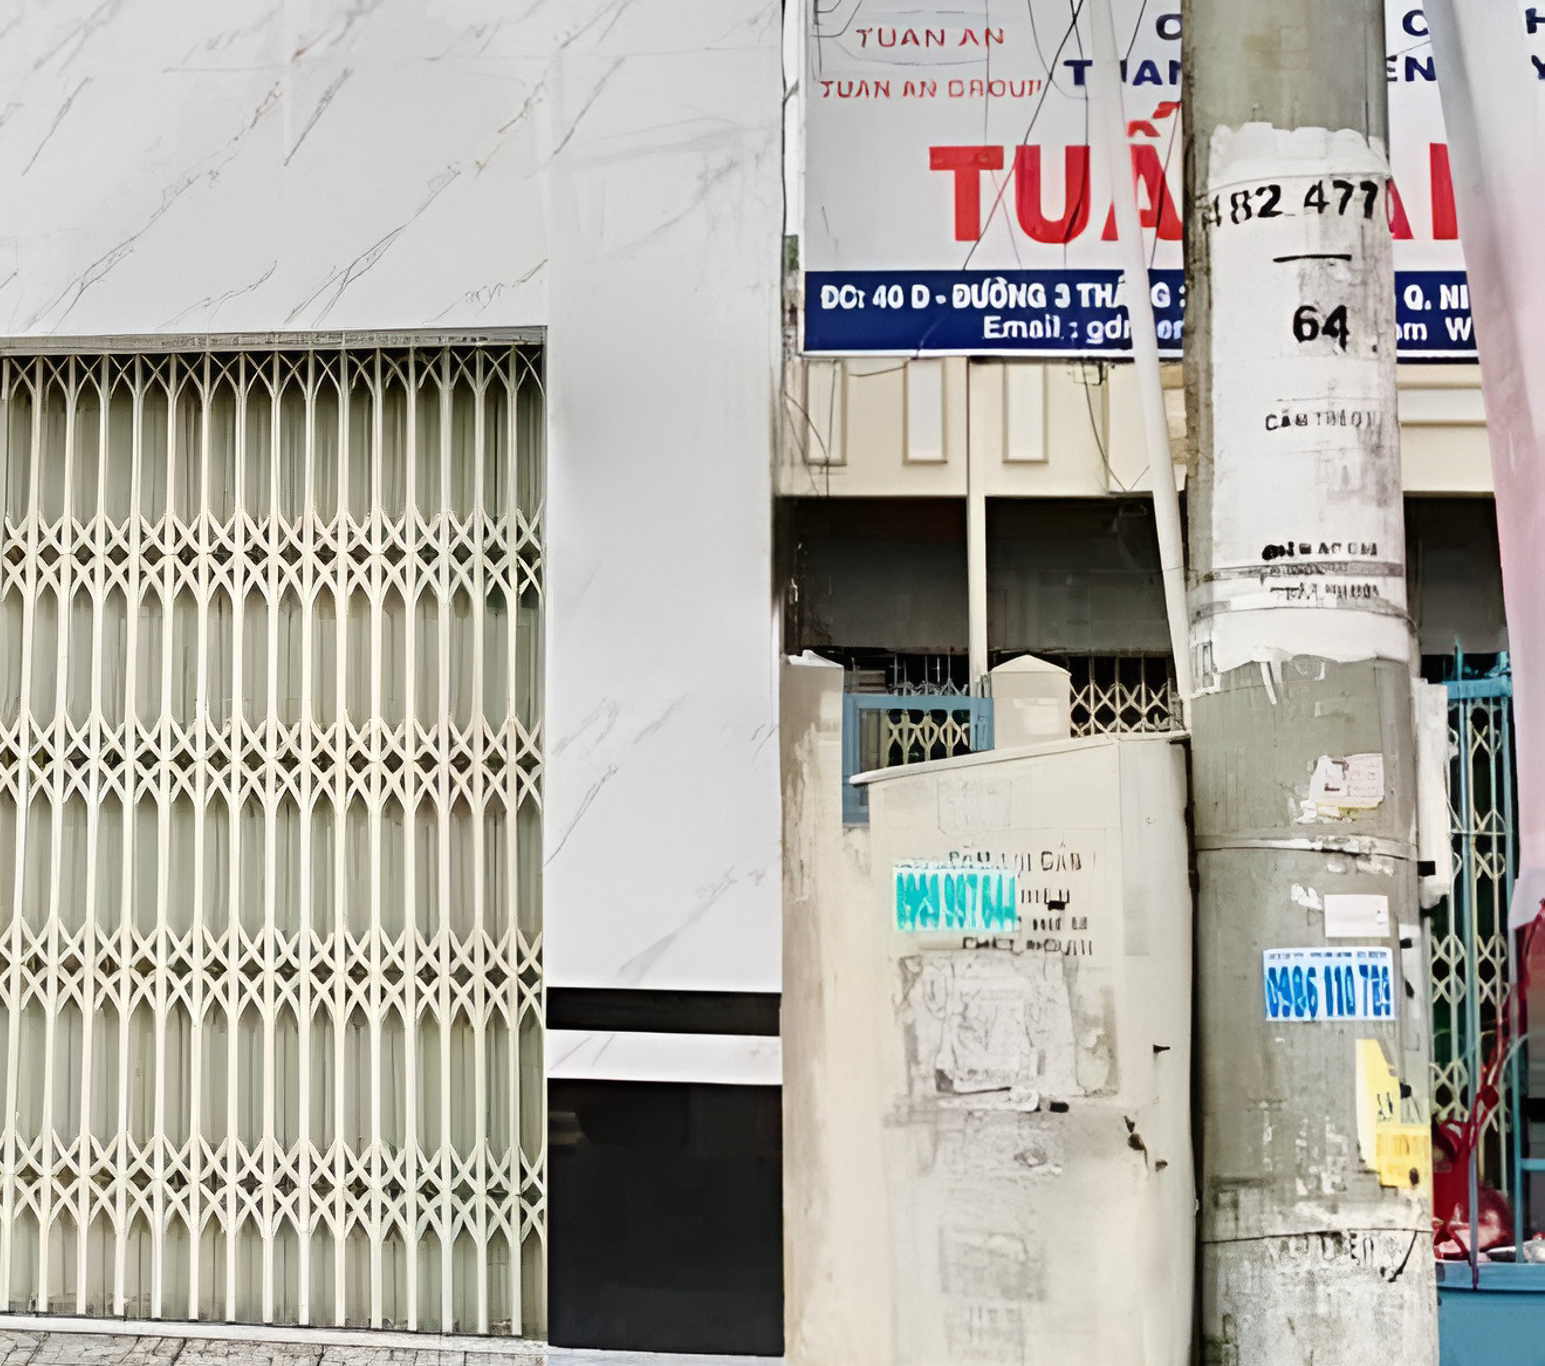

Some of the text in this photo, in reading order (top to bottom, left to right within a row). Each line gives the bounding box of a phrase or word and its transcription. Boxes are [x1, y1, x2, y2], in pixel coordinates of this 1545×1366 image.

[856, 27, 1004, 48] TUAN AN
[1303, 180, 1379, 219] 477
[872, 284, 905, 309] 40
[1292, 304, 1351, 349] 64
